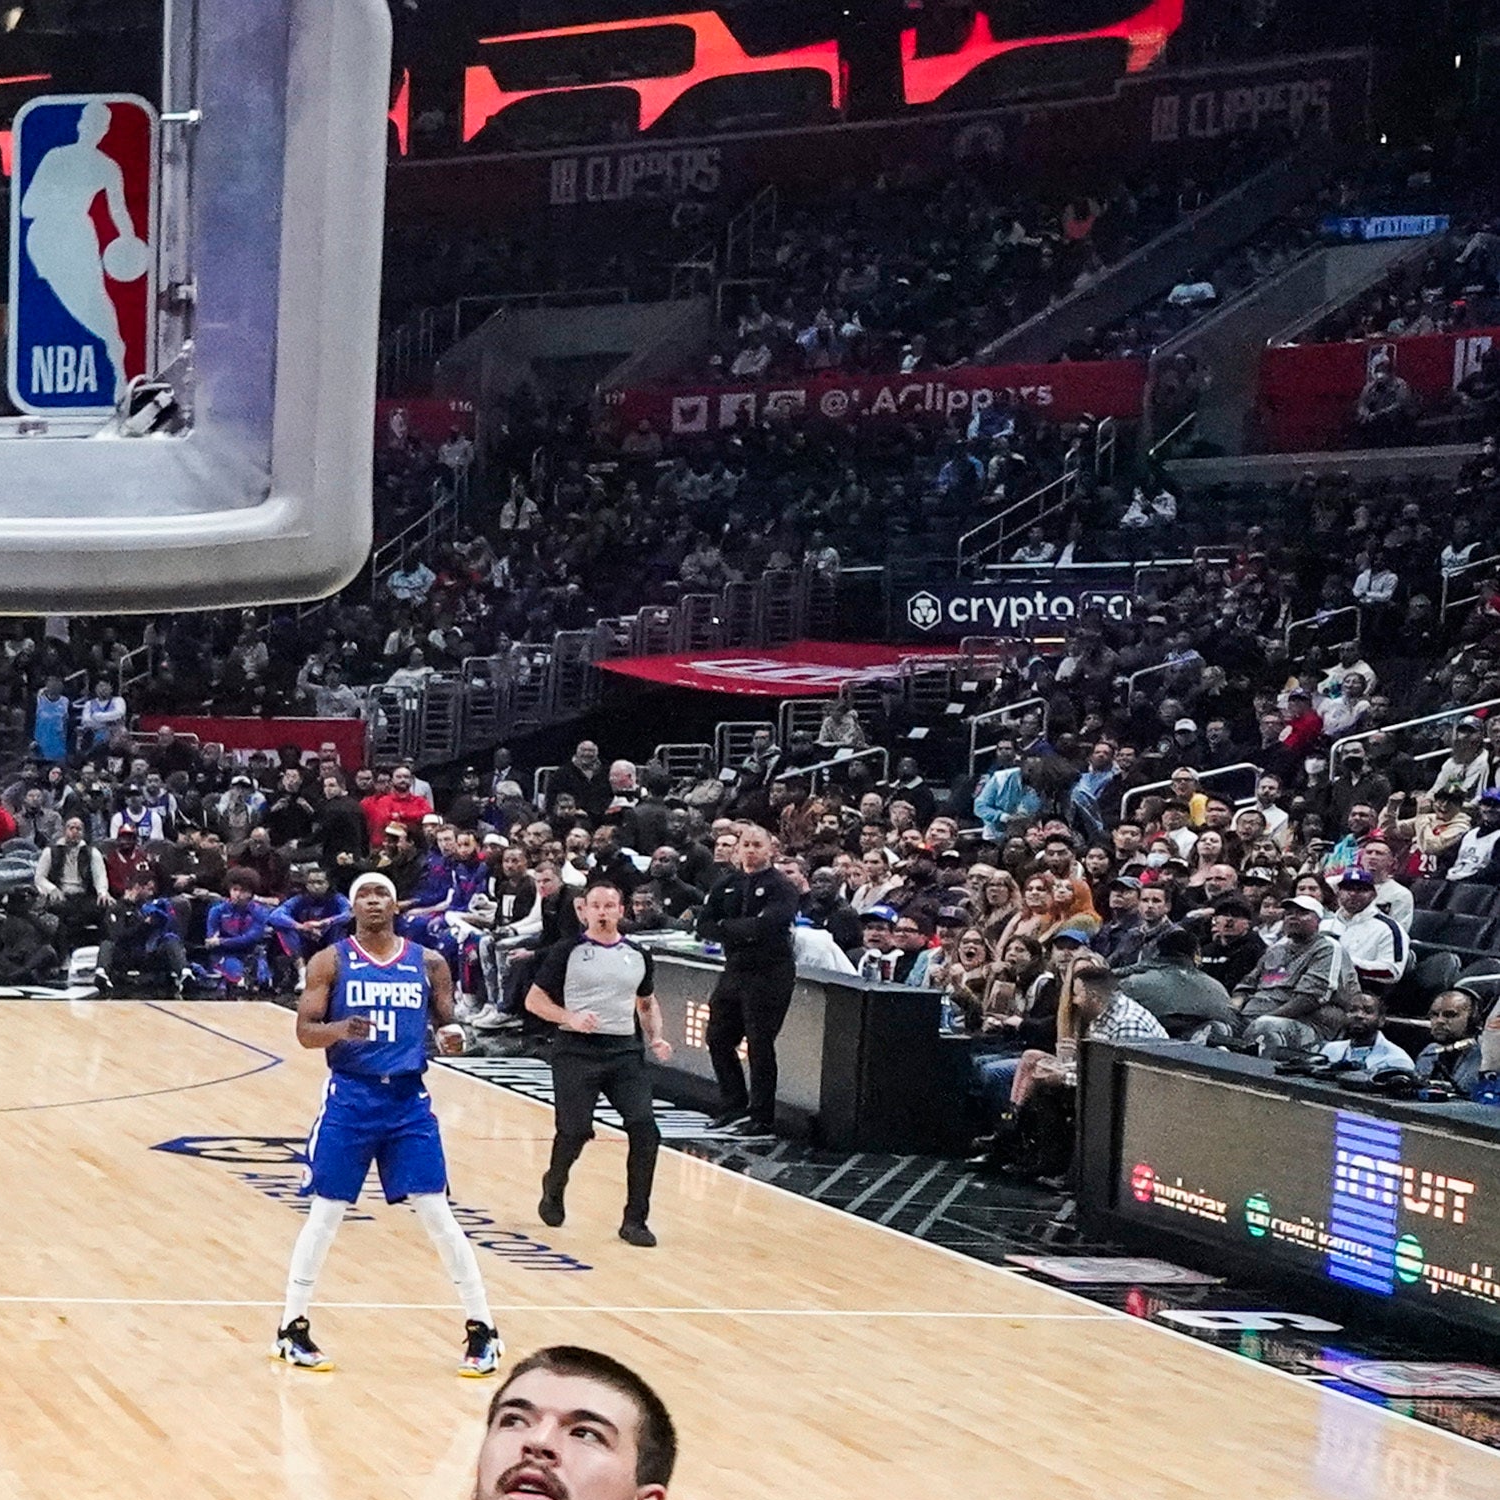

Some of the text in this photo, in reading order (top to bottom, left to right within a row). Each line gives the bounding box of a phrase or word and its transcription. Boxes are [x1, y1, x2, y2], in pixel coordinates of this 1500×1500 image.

[31, 345, 98, 394] NBA
[346, 981, 422, 1009] CLIPPERS
[369, 1010, 396, 1042] 14
